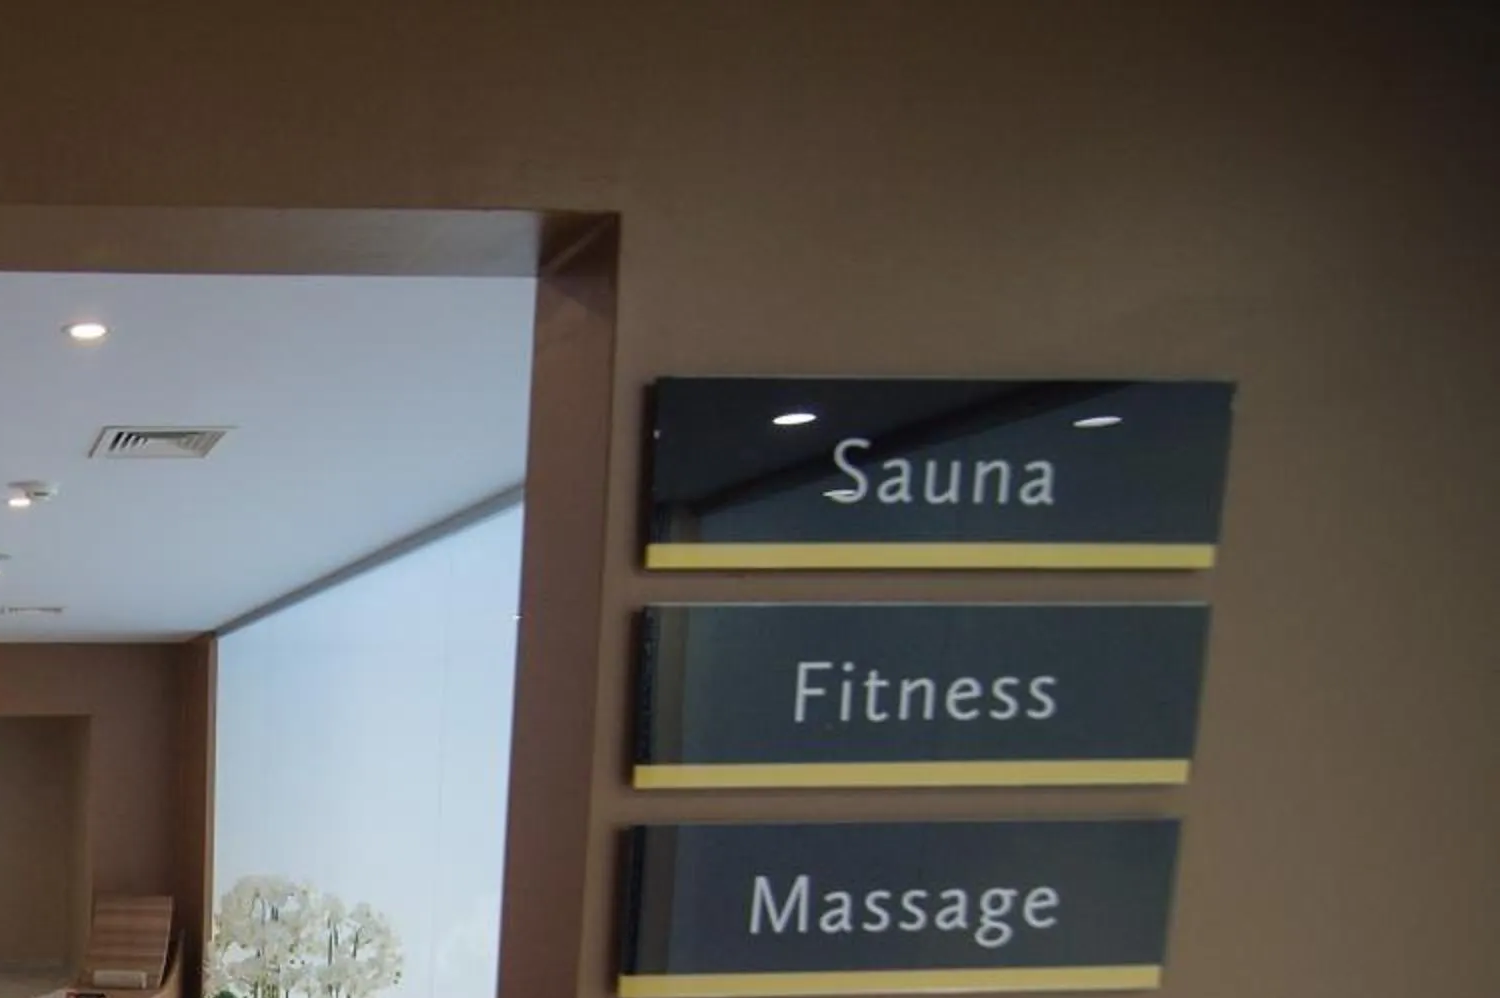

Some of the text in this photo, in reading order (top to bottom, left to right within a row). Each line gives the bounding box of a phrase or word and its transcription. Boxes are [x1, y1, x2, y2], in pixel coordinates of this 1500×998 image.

[828, 437, 1056, 504] Sauna
[793, 660, 1058, 723] Fitness
[748, 874, 1060, 949] Massage
